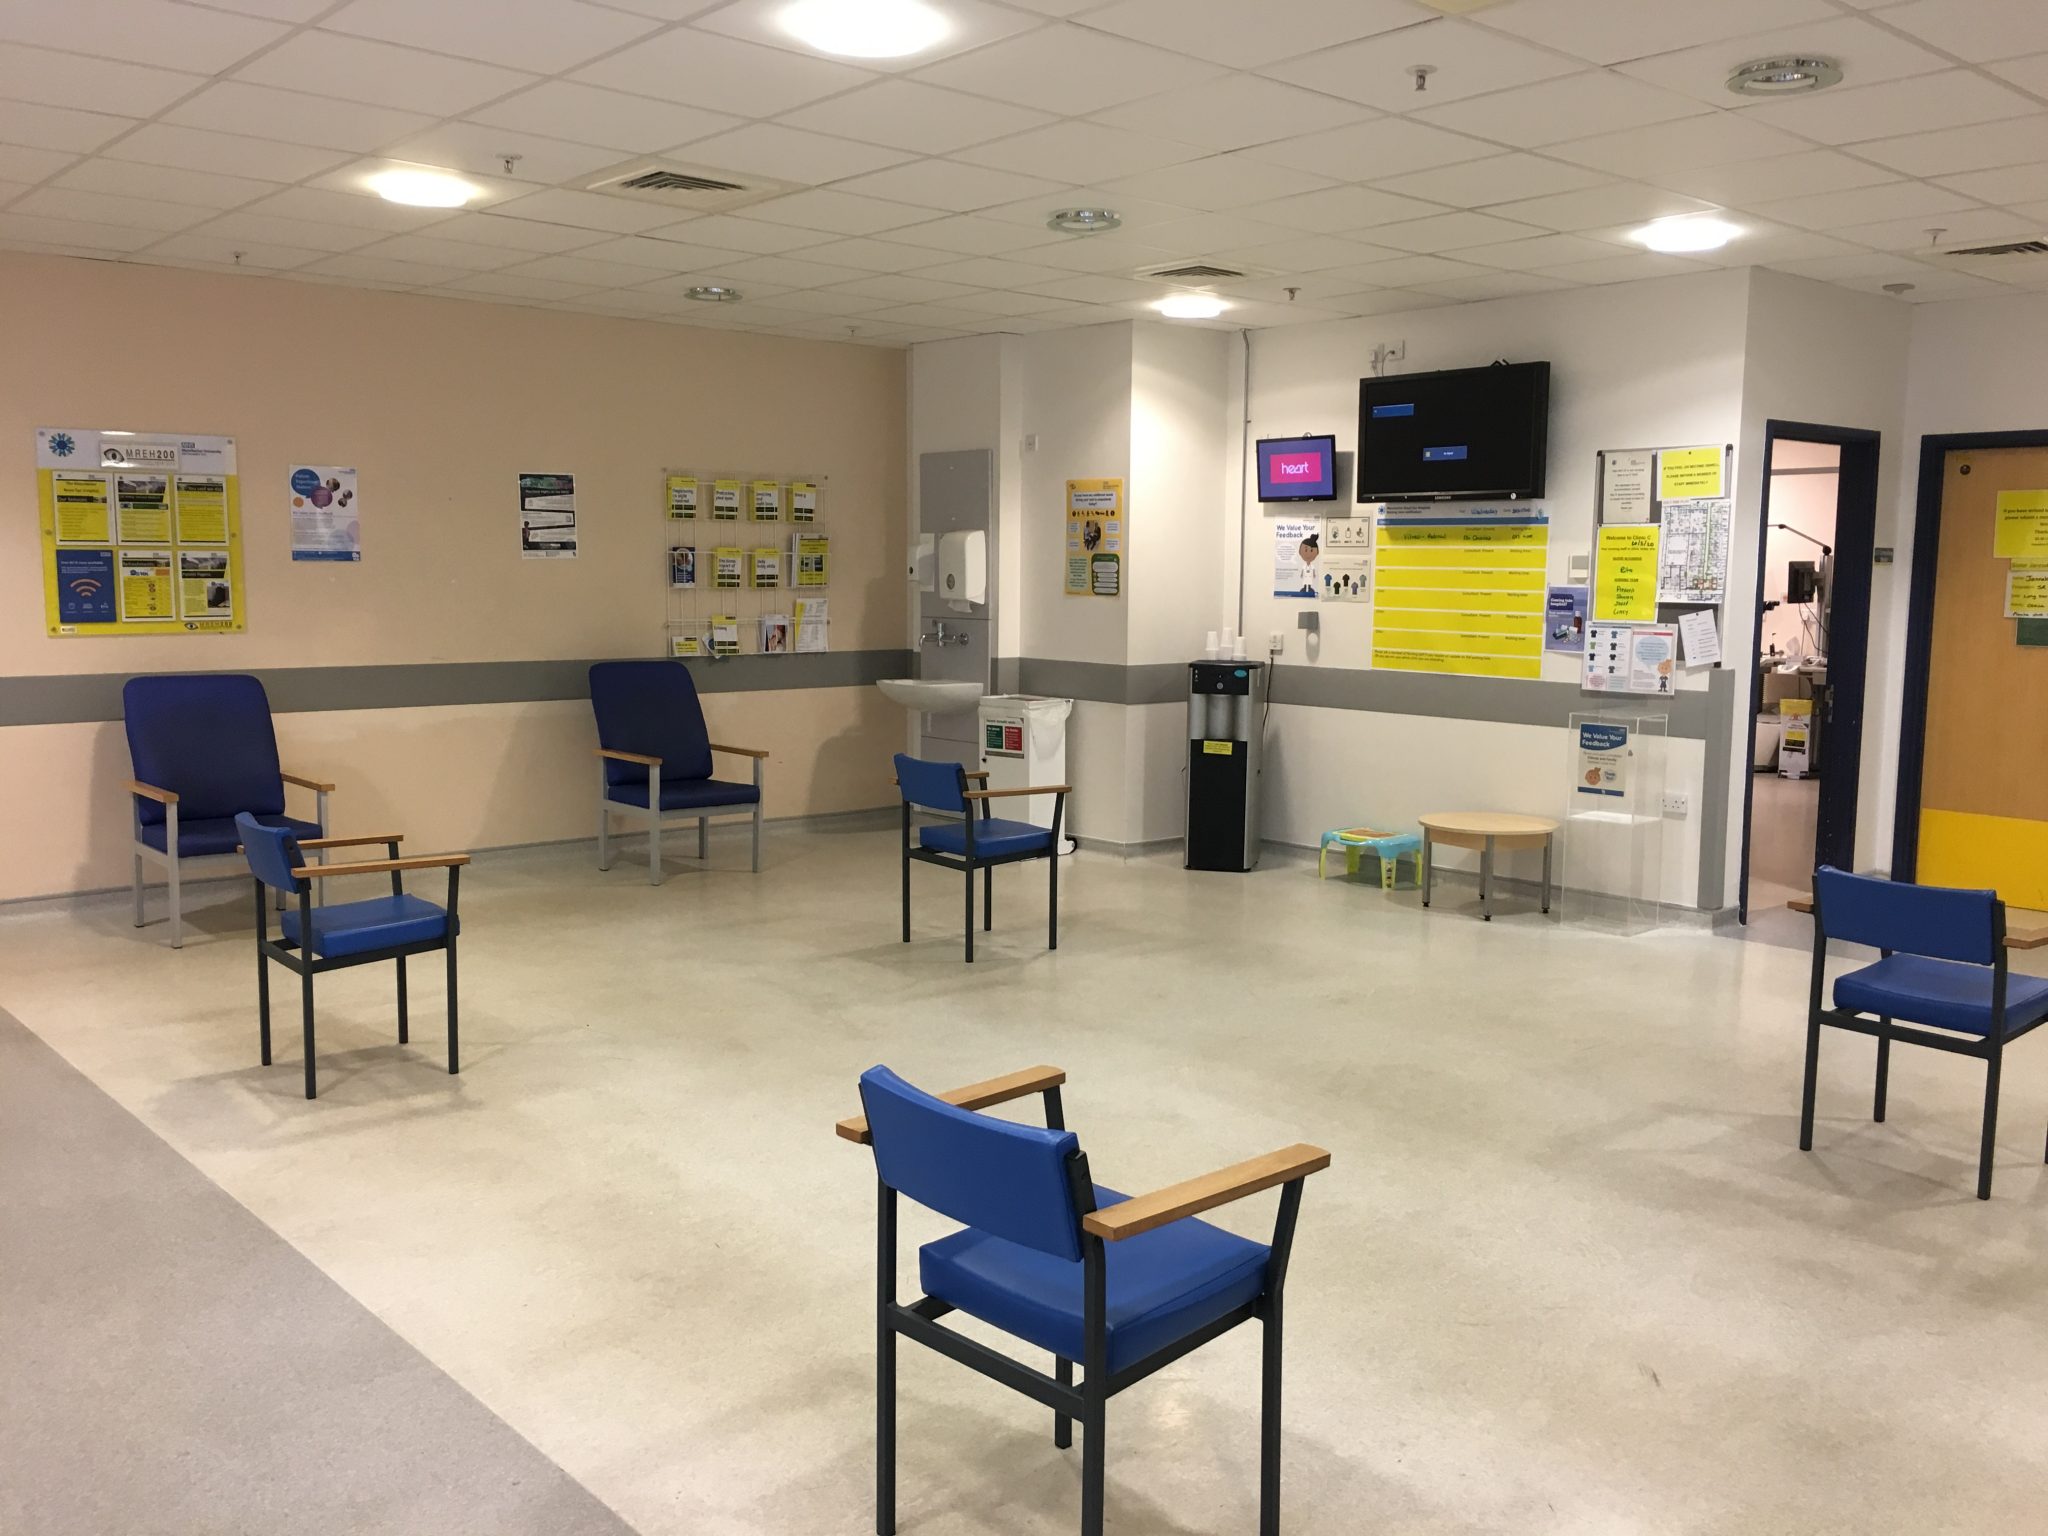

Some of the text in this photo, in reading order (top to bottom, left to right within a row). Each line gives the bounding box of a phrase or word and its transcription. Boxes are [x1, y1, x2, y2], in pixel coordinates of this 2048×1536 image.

[126, 448, 175, 459] MREH200
[1281, 461, 1309, 474] heart
[1592, 732, 1608, 740] Value
[1581, 739, 1610, 747] Feedback
